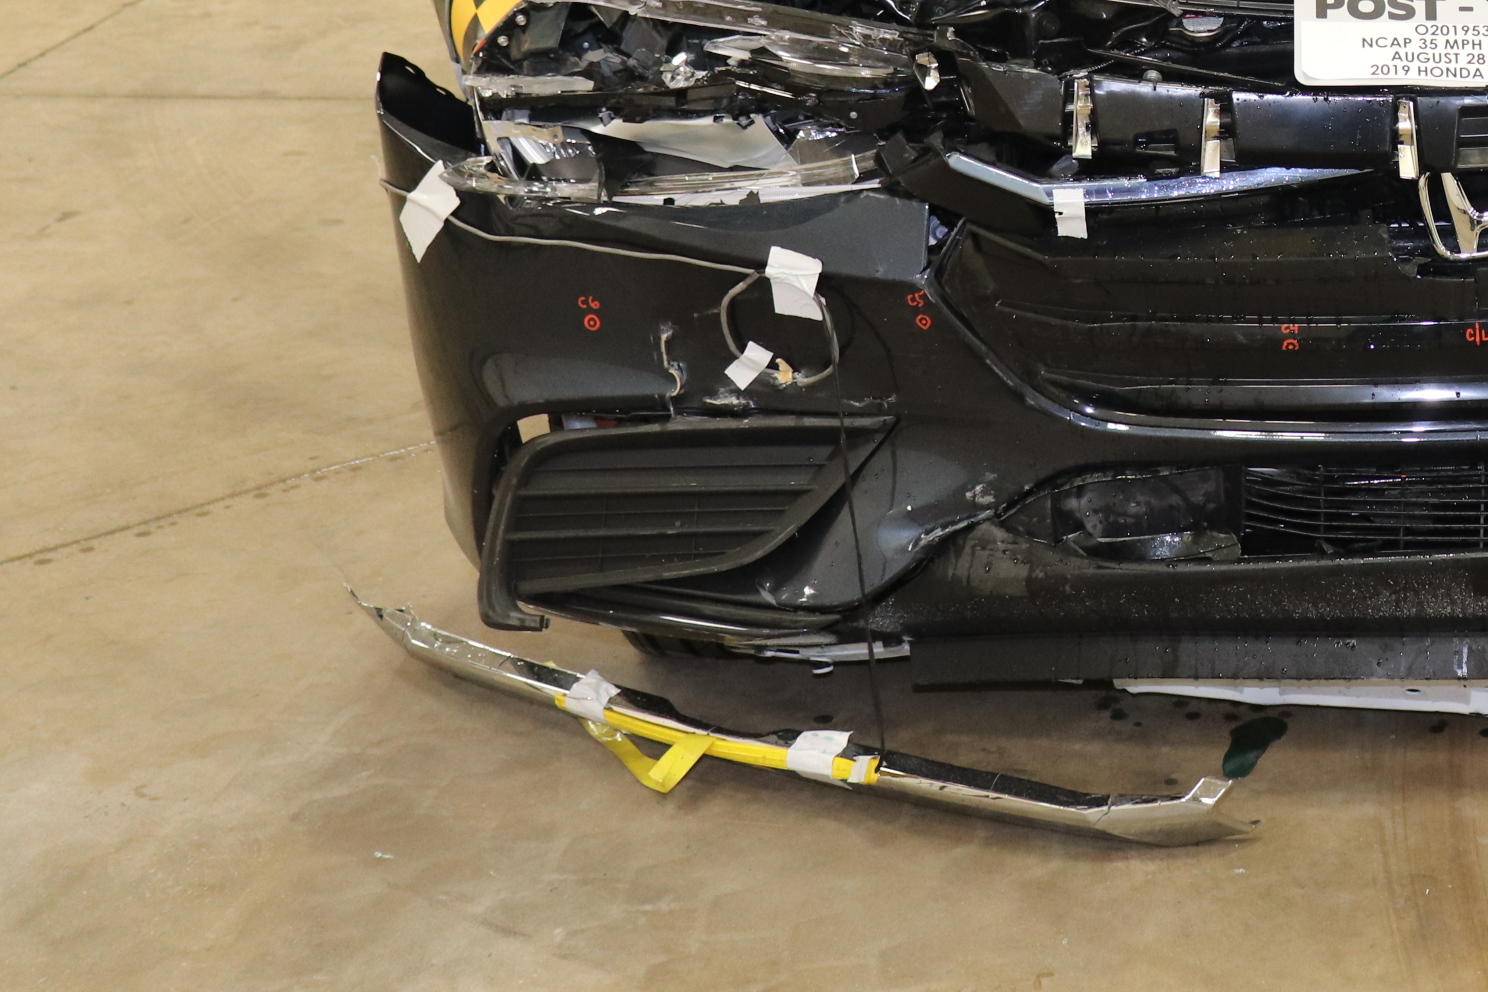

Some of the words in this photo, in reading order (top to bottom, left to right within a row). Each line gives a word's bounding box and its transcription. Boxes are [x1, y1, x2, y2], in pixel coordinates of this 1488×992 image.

[1362, 37, 1412, 49] NCAP
[1418, 38, 1438, 50] 35
[1444, 38, 1482, 51] MPH
[1391, 51, 1460, 64] AUGUST
[1370, 64, 1411, 76] 2019
[1417, 66, 1484, 79] HONDA
[577, 295, 602, 310] C6
[907, 290, 925, 307] C5
